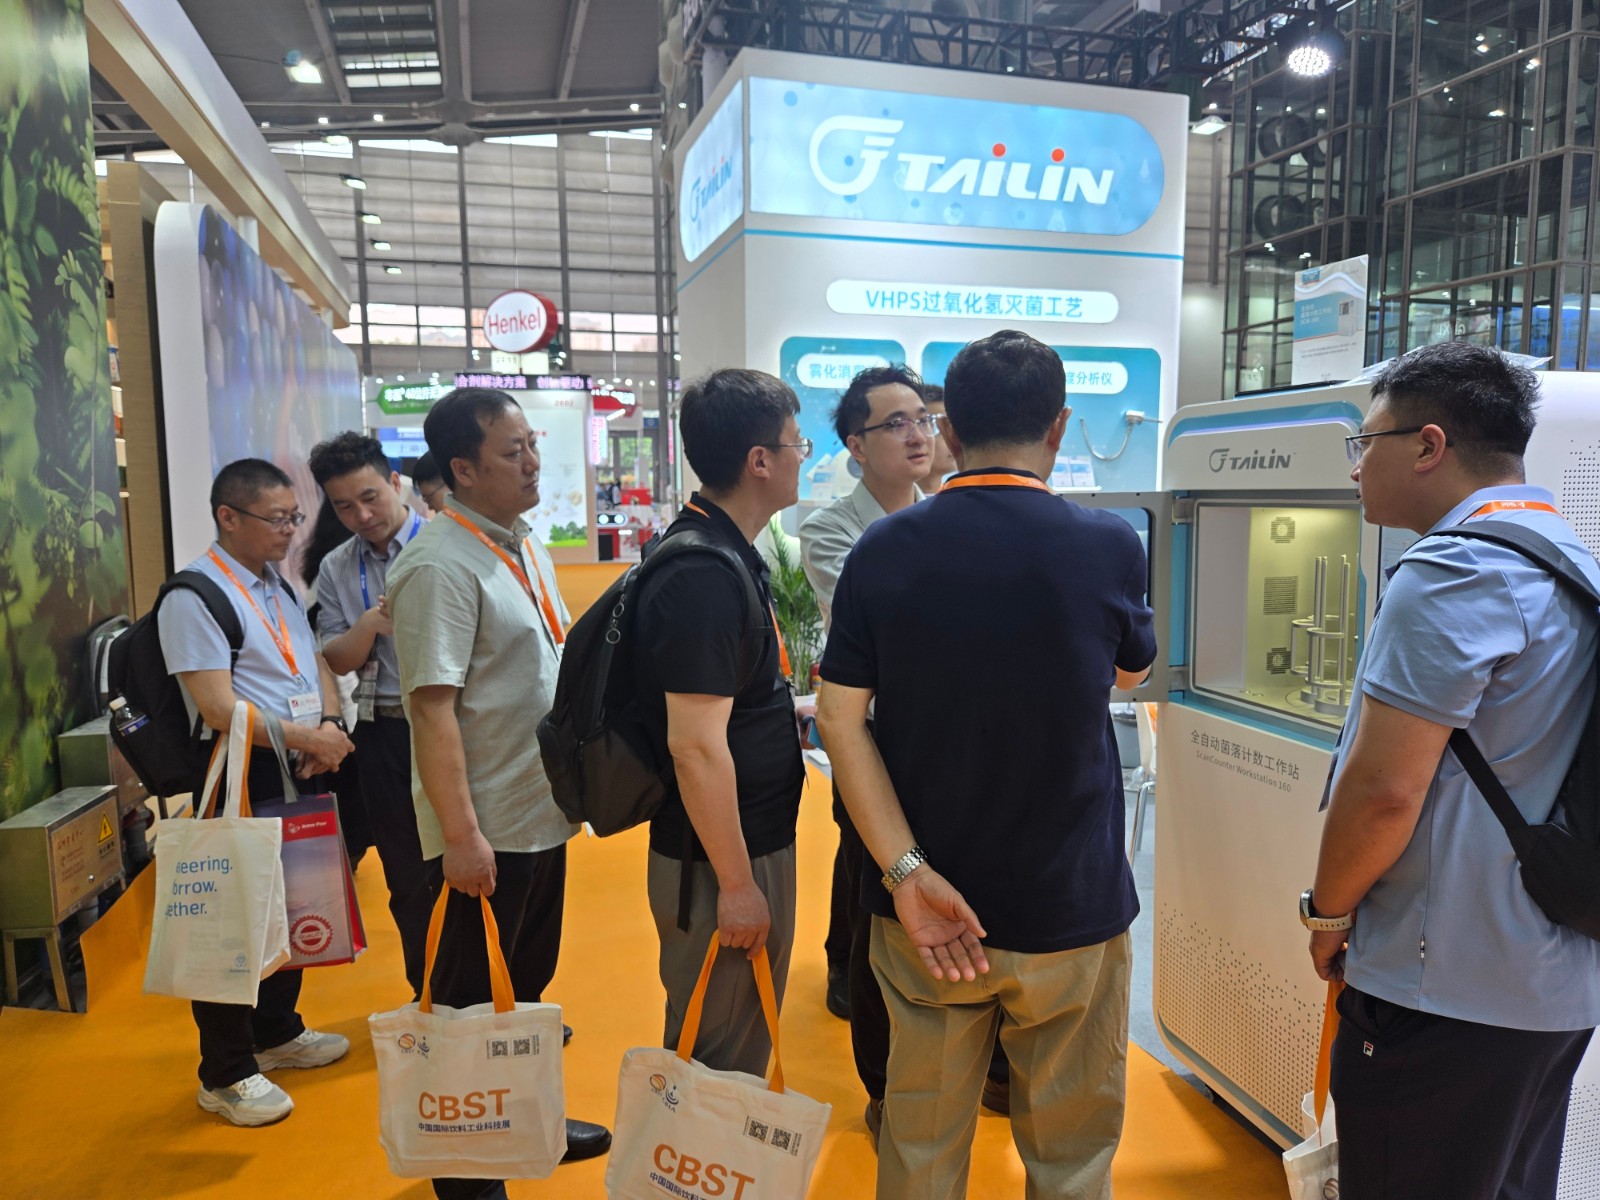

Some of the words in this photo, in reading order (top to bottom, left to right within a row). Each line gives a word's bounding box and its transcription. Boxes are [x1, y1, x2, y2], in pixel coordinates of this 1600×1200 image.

[866, 290, 1083, 318] VHPS过氧化氢灭菌工艺
[488, 306, 541, 337] Henkel
[1191, 729, 1300, 781] 全自动菌落计数工作站
[1195, 750, 1236, 773] ScanCounter
[1236, 764, 1278, 788] Workstation
[1278, 780, 1292, 793] 160
[418, 1087, 511, 1121] CBST
[418, 1119, 511, 1133] 中国国际饮料工业科技展
[653, 1143, 756, 1200] CBST
